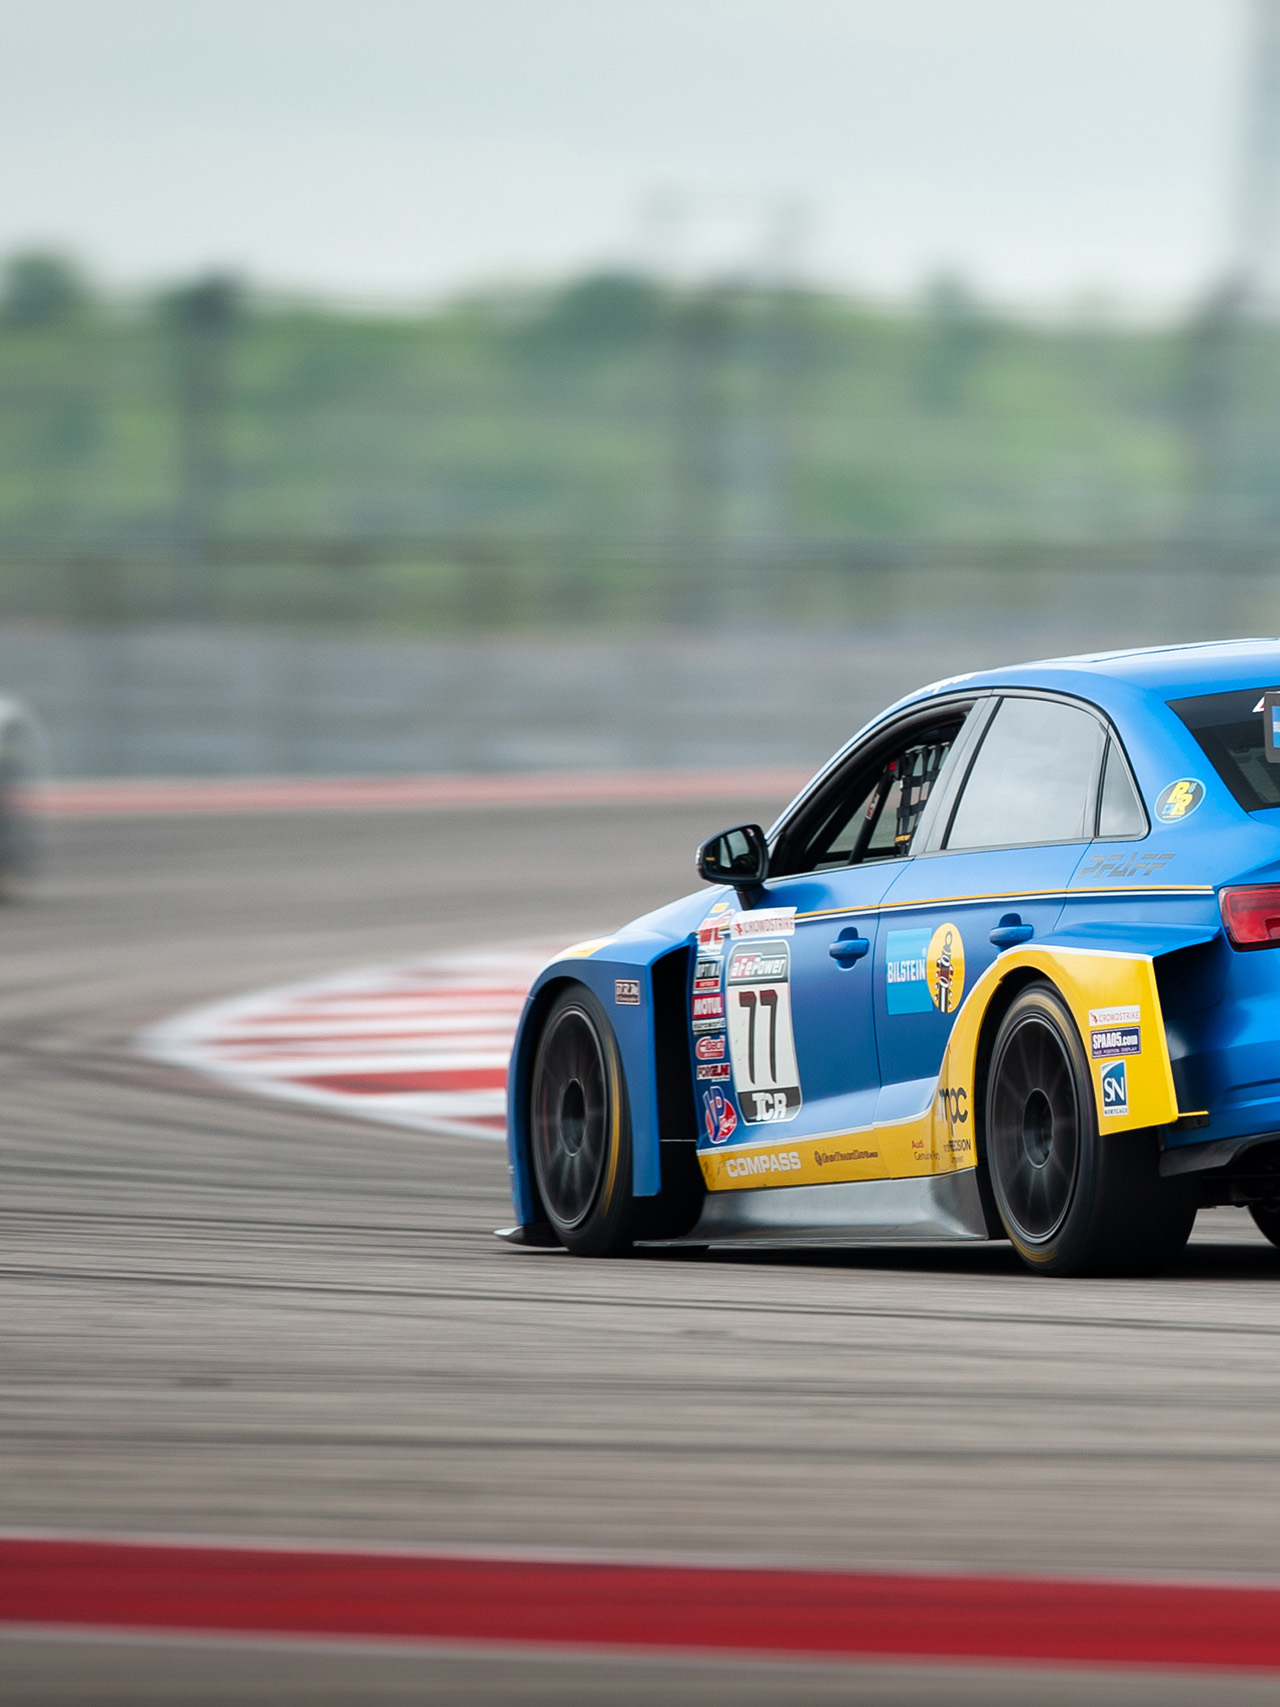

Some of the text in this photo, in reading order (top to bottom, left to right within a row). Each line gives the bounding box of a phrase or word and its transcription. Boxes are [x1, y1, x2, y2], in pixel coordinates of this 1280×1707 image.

[693, 996, 723, 1016] MOTUL
[1098, 1011, 1140, 1023] CROWDSTRIKE
[738, 989, 779, 1085] 77
[1103, 1076, 1126, 1103] SN
[752, 1091, 788, 1122] TCR
[725, 1151, 802, 1177] COMPASS
